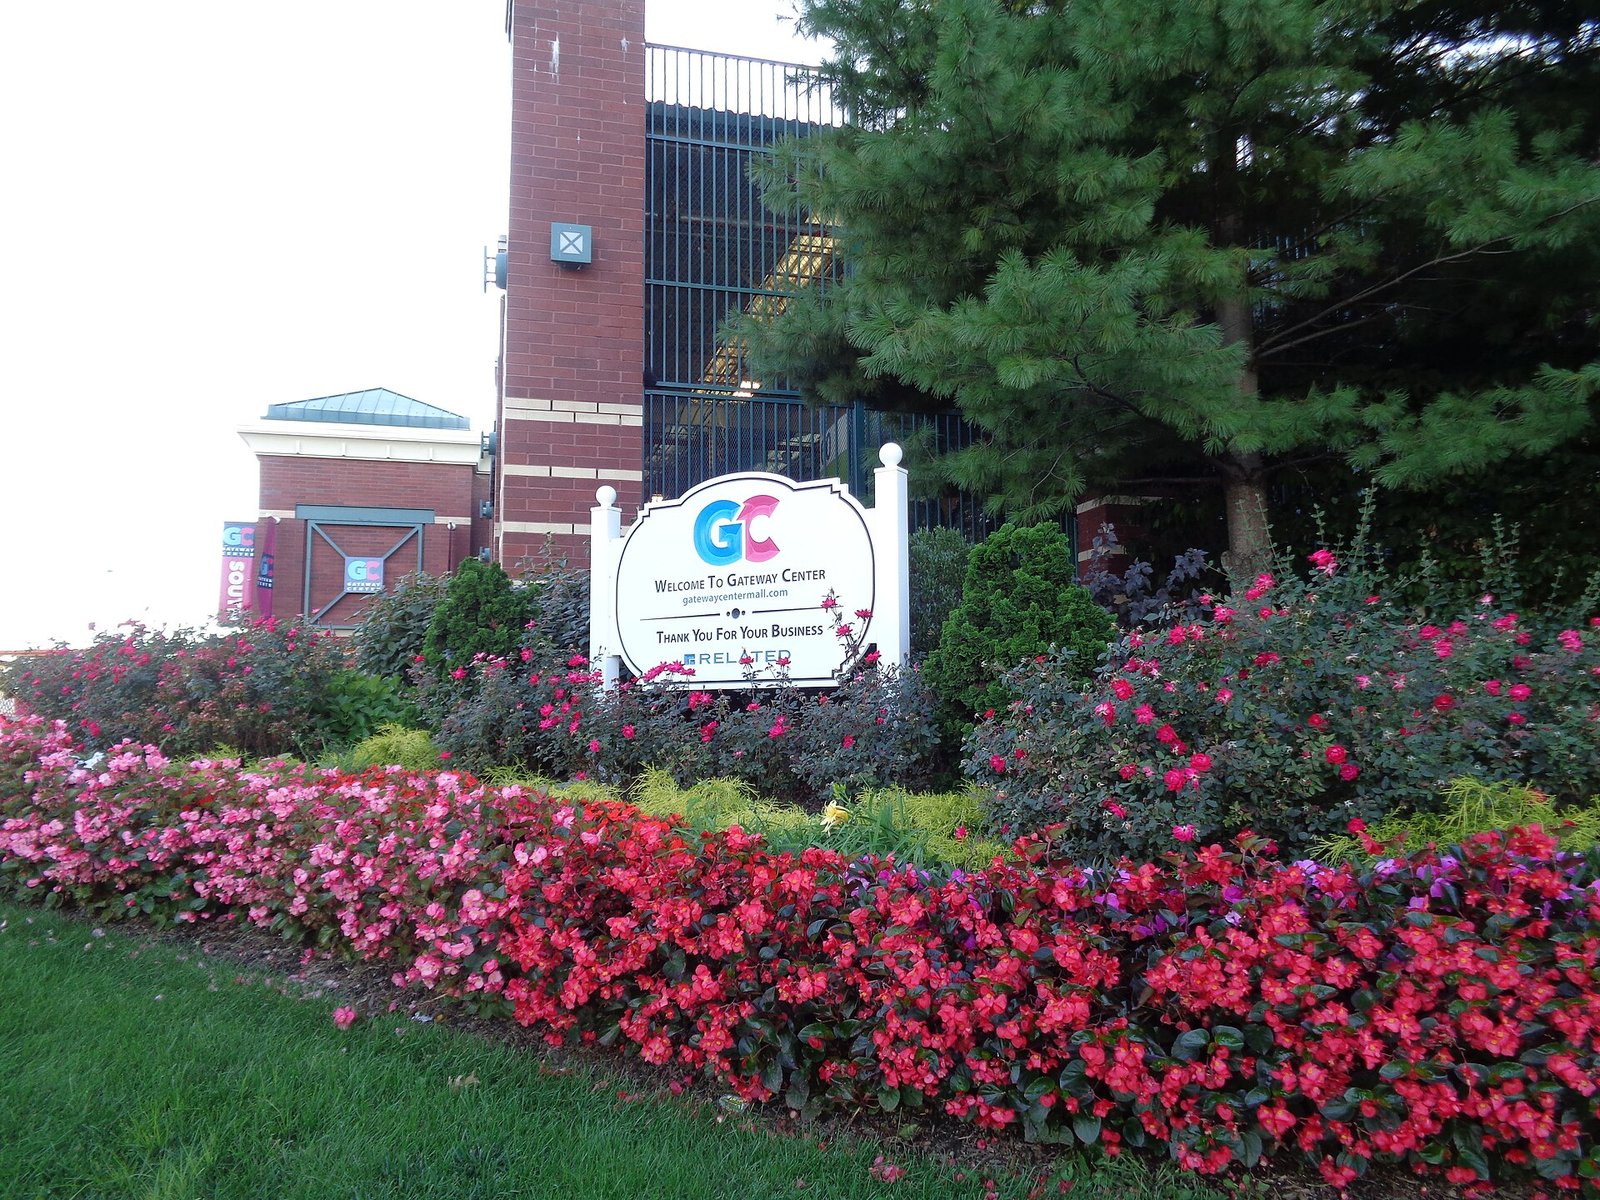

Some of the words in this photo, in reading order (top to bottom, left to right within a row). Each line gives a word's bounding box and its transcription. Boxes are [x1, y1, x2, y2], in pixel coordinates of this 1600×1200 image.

[223, 527, 254, 546] GC
[693, 494, 780, 566] GC
[348, 560, 380, 580] GC
[654, 579, 705, 593] WELCOME
[708, 575, 723, 589] TO
[727, 573, 778, 587] GATEWAY
[782, 568, 826, 582] CENTER
[682, 588, 788, 606] gatewaycentermall.com
[656, 631, 690, 644] THANK
[692, 629, 713, 642] YOU
[716, 627, 737, 640] FOR
[740, 626, 768, 639] YOUR
[771, 624, 823, 638] BUSINESS
[699, 649, 791, 665] RELATED
